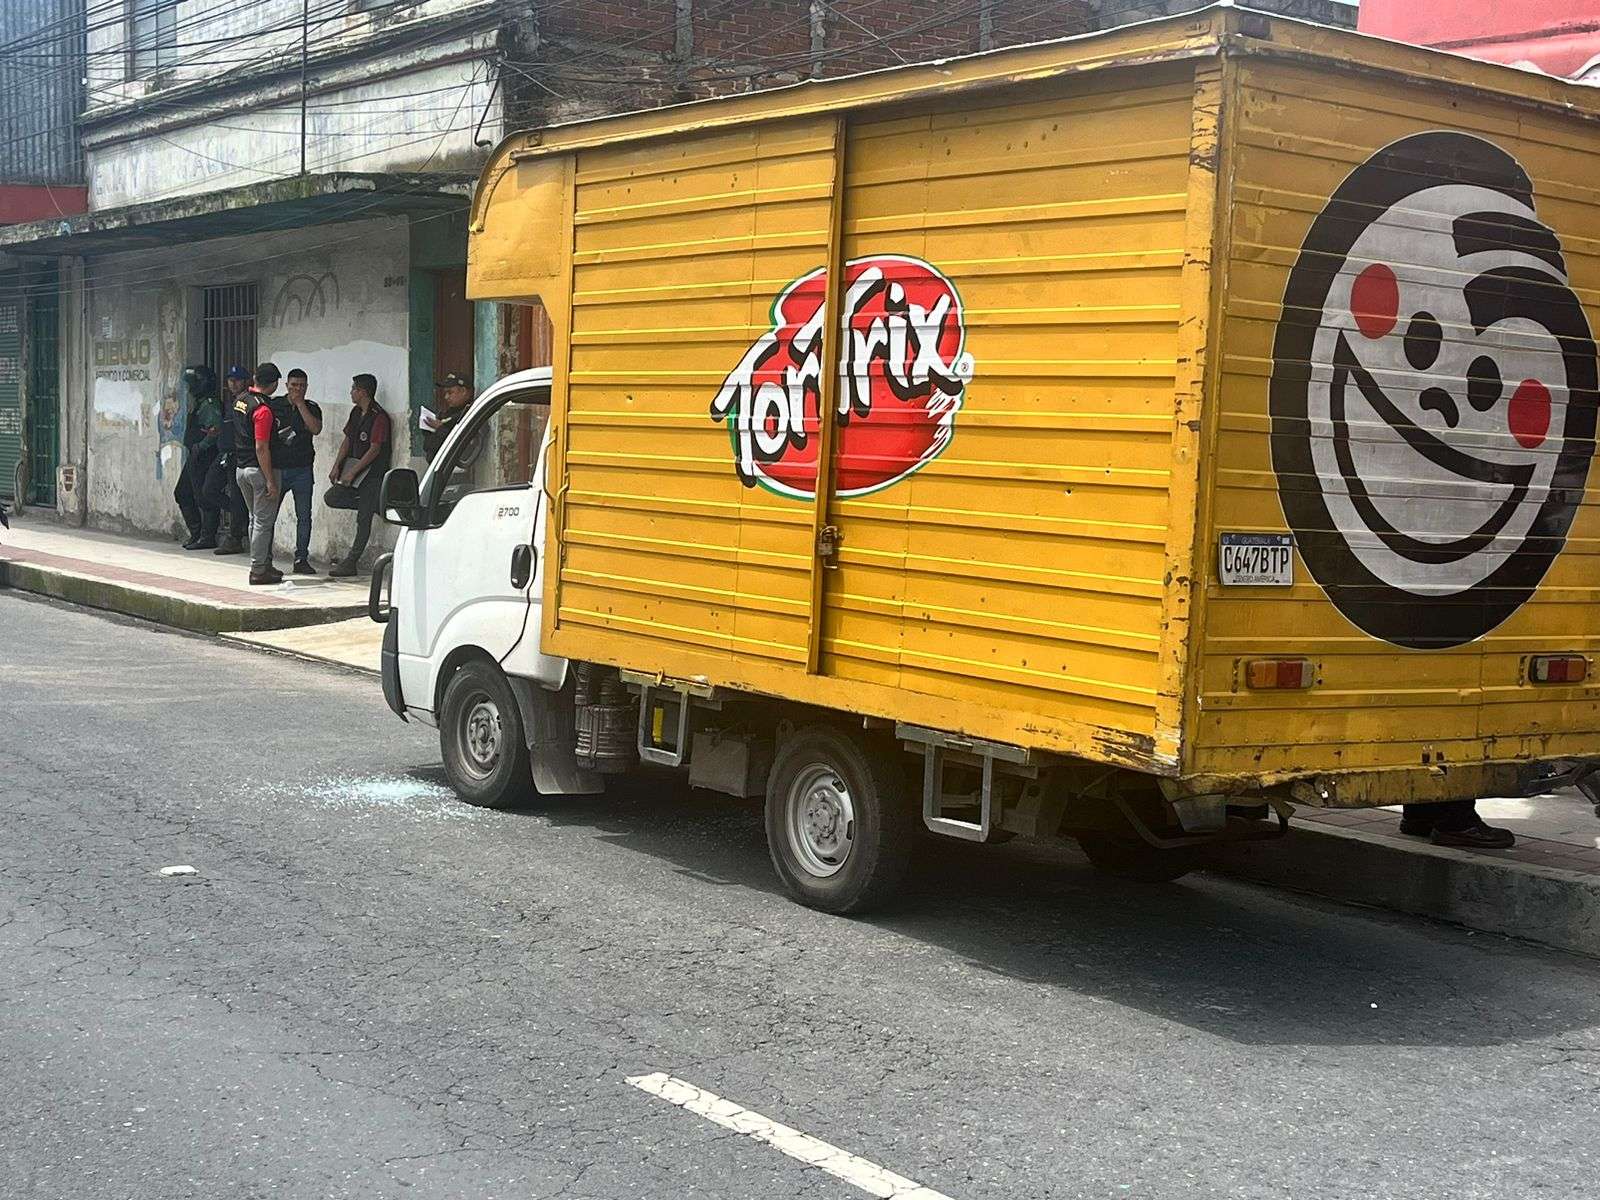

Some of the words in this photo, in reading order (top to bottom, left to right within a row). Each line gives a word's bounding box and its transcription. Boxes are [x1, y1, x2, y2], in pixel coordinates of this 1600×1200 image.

[94, 339, 151, 367] DIBUJO
[498, 506, 520, 517] 2700
[1224, 547, 1289, 573] C647BTP
